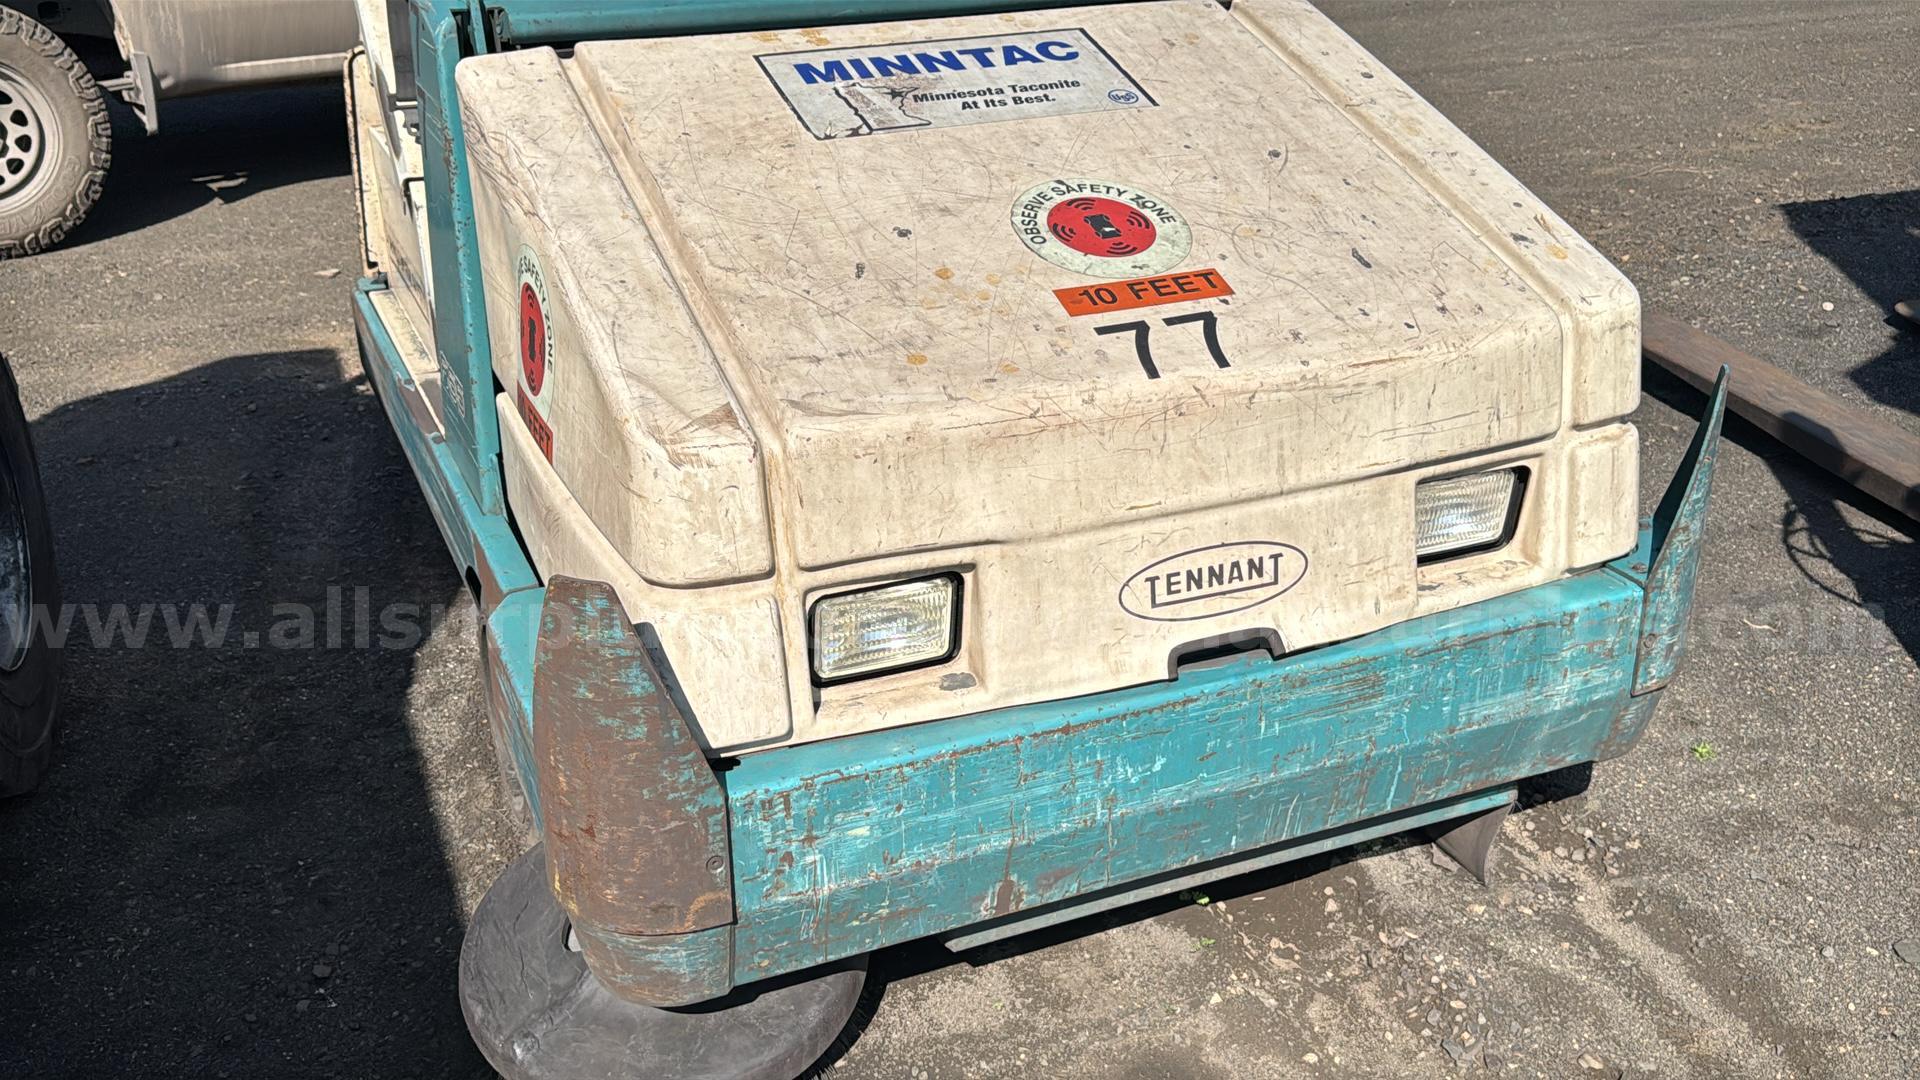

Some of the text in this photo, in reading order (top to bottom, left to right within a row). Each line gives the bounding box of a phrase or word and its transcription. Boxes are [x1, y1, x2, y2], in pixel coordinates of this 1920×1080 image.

[793, 41, 1080, 85] MINNTAC
[912, 79, 1081, 103] Minnesota Taconite
[961, 93, 1057, 110] At Its Best.
[1020, 182, 1178, 245] OBSERVE SAFETY ZONE
[1078, 272, 1219, 306] 10 FEET
[1093, 311, 1232, 380] 77
[1144, 552, 1284, 609] TENNANT
